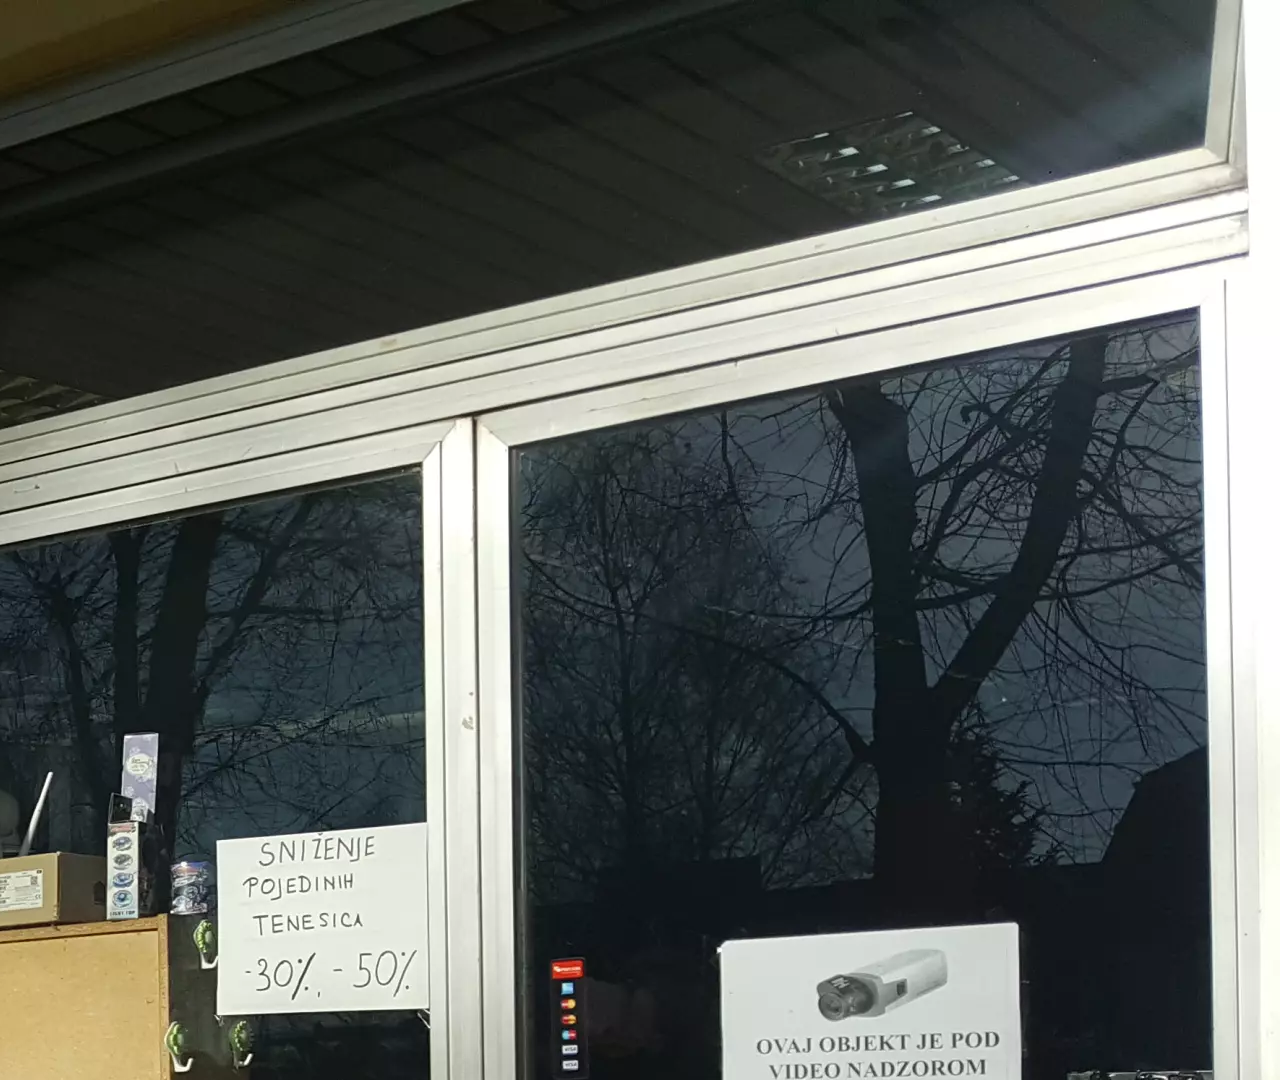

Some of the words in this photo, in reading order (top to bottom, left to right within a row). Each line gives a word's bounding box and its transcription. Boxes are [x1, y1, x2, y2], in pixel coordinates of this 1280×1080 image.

[258, 832, 376, 867] SNIŽENJE
[242, 873, 354, 901] POJEDINIH
[252, 912, 364, 936] TENESICA
[756, 1038, 812, 1055] OVAJ
[819, 1035, 911, 1053] OBJEKT
[916, 1033, 944, 1050] JE
[951, 1031, 1001, 1049] POD
[769, 1063, 841, 1080] VIDEO
[847, 1059, 987, 1079] NADZOROM
